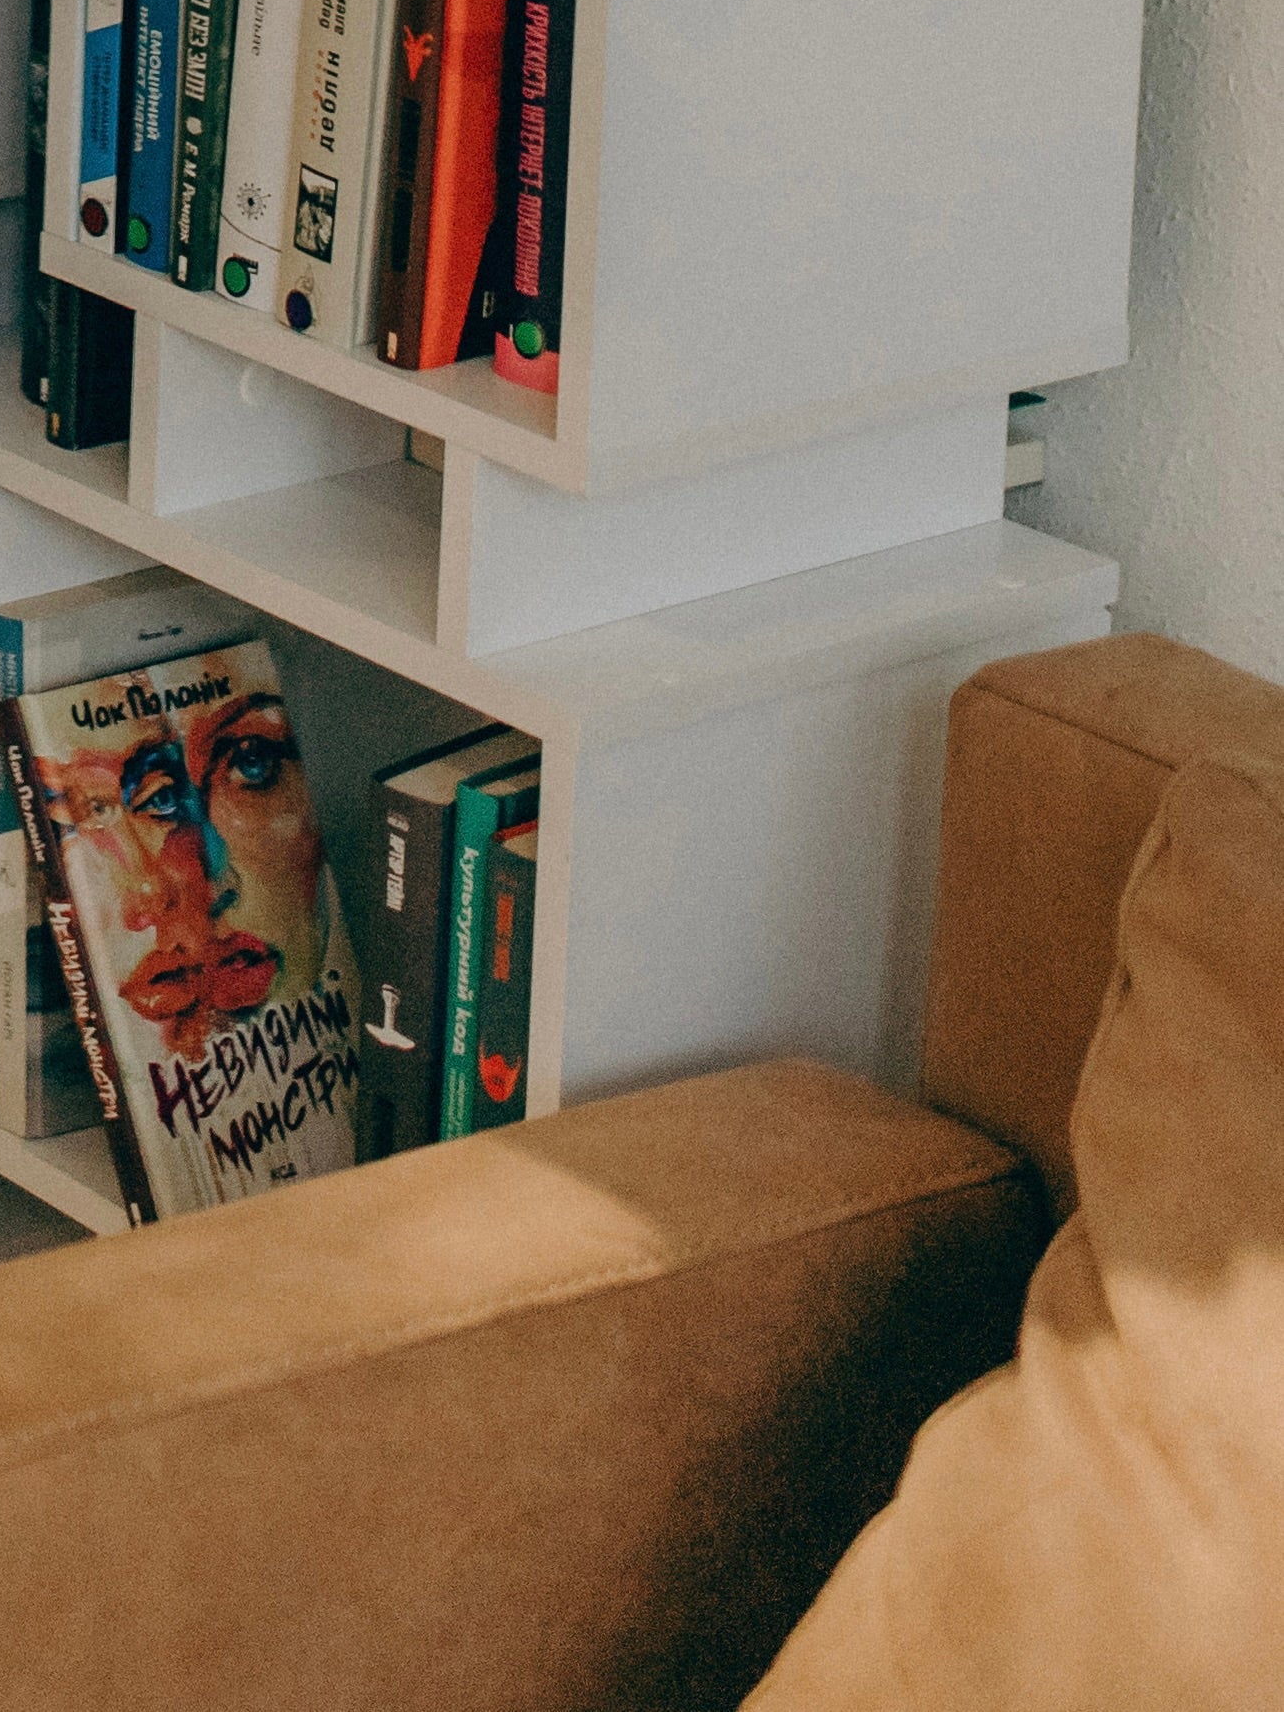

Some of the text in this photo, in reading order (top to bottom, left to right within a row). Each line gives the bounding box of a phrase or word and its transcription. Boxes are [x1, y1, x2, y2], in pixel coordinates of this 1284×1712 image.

[133, 5, 149, 153] ІНТЕЛЕКТ ЛІДЕРА
[184, 47, 208, 103] ЗМІН
[188, 11, 211, 47] БЕЗ
[146, 29, 164, 141] ЕМОЦІЙНИЙ
[319, 50, 341, 153] деблін
[515, 1, 550, 297] КРИХКІСТЬ ІНТЕРНЕТ-ПОКОЛІННЯ
[179, 181, 196, 244] Ремарк
[456, 845, 480, 1002] культурний
[451, 1006, 473, 1057] код
